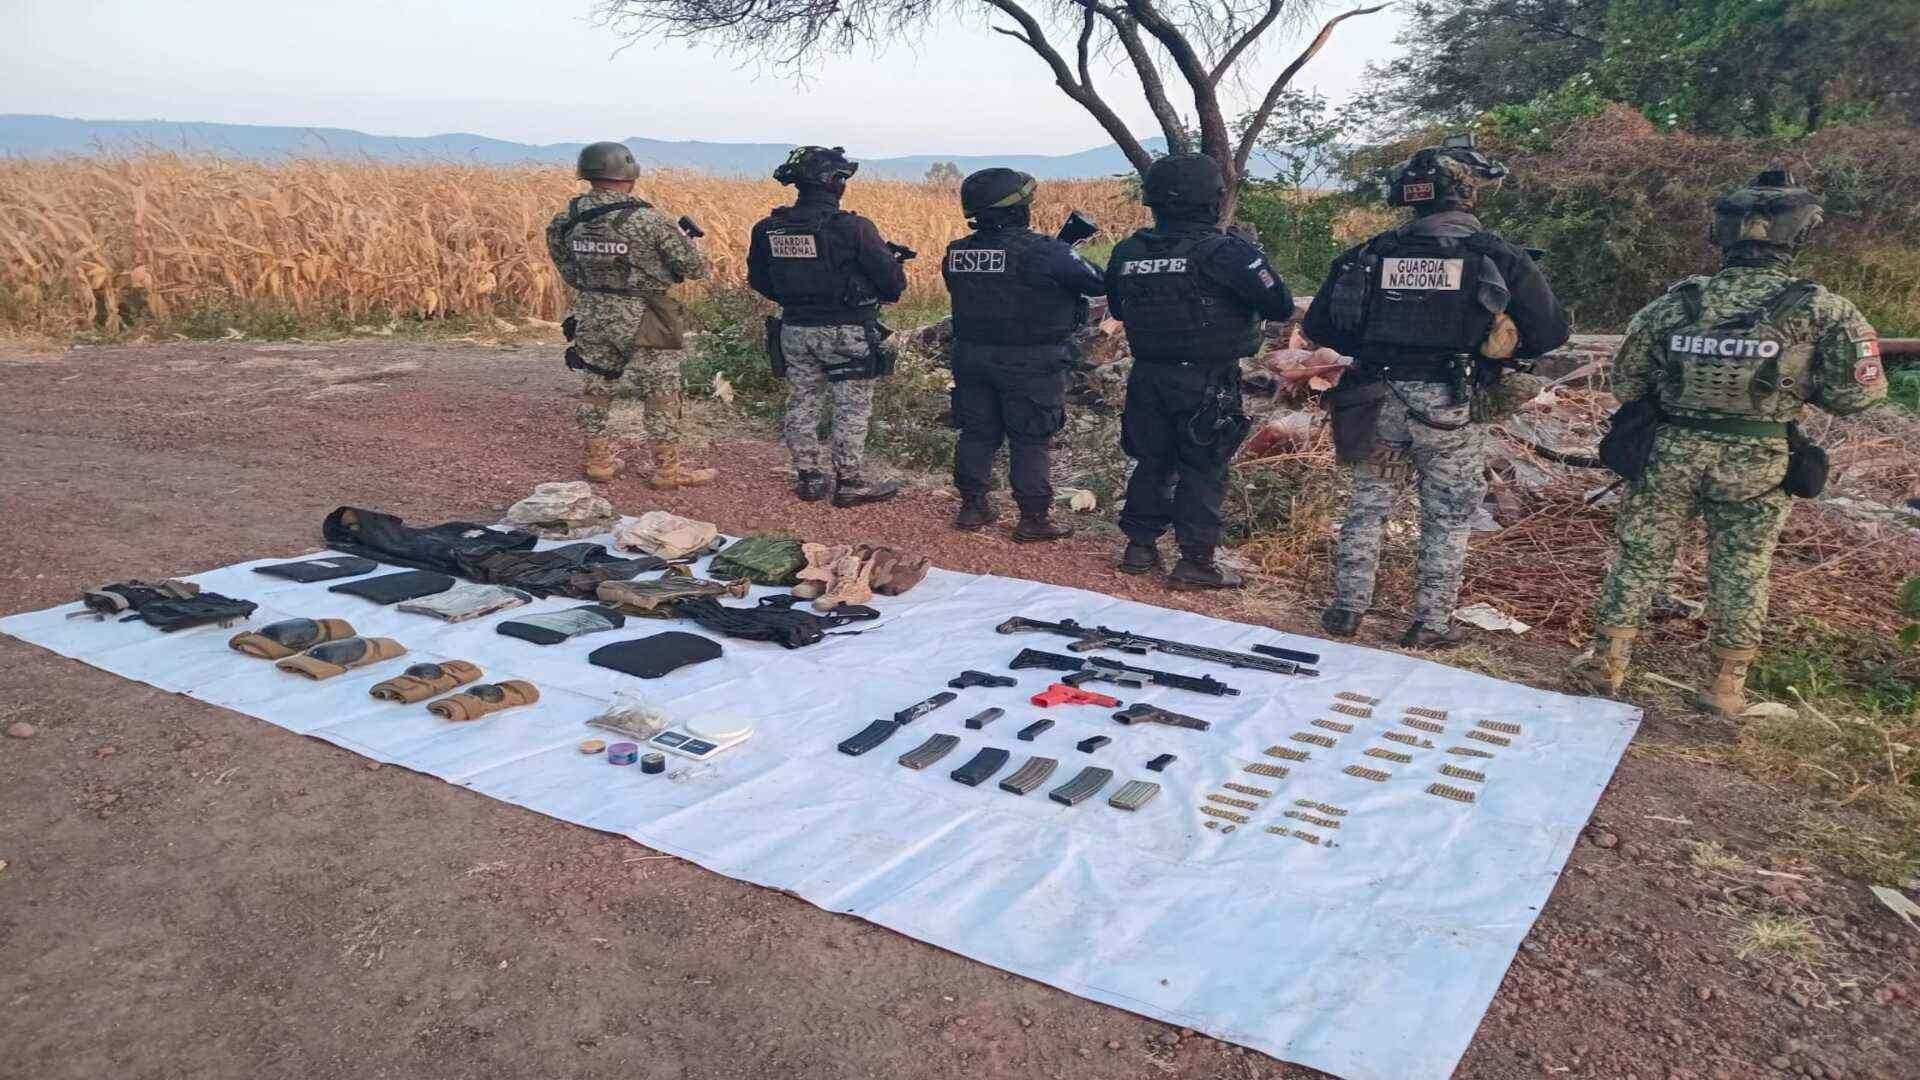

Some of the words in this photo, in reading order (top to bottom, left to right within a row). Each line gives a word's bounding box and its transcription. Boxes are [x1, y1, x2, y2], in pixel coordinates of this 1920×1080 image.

[773, 236, 810, 246] GUARDIA
[774, 246, 816, 256] NACIONAL
[1121, 258, 1187, 275] FSPE
[1397, 260, 1445, 273] GUARDIA
[1389, 273, 1451, 288] NACIONAL
